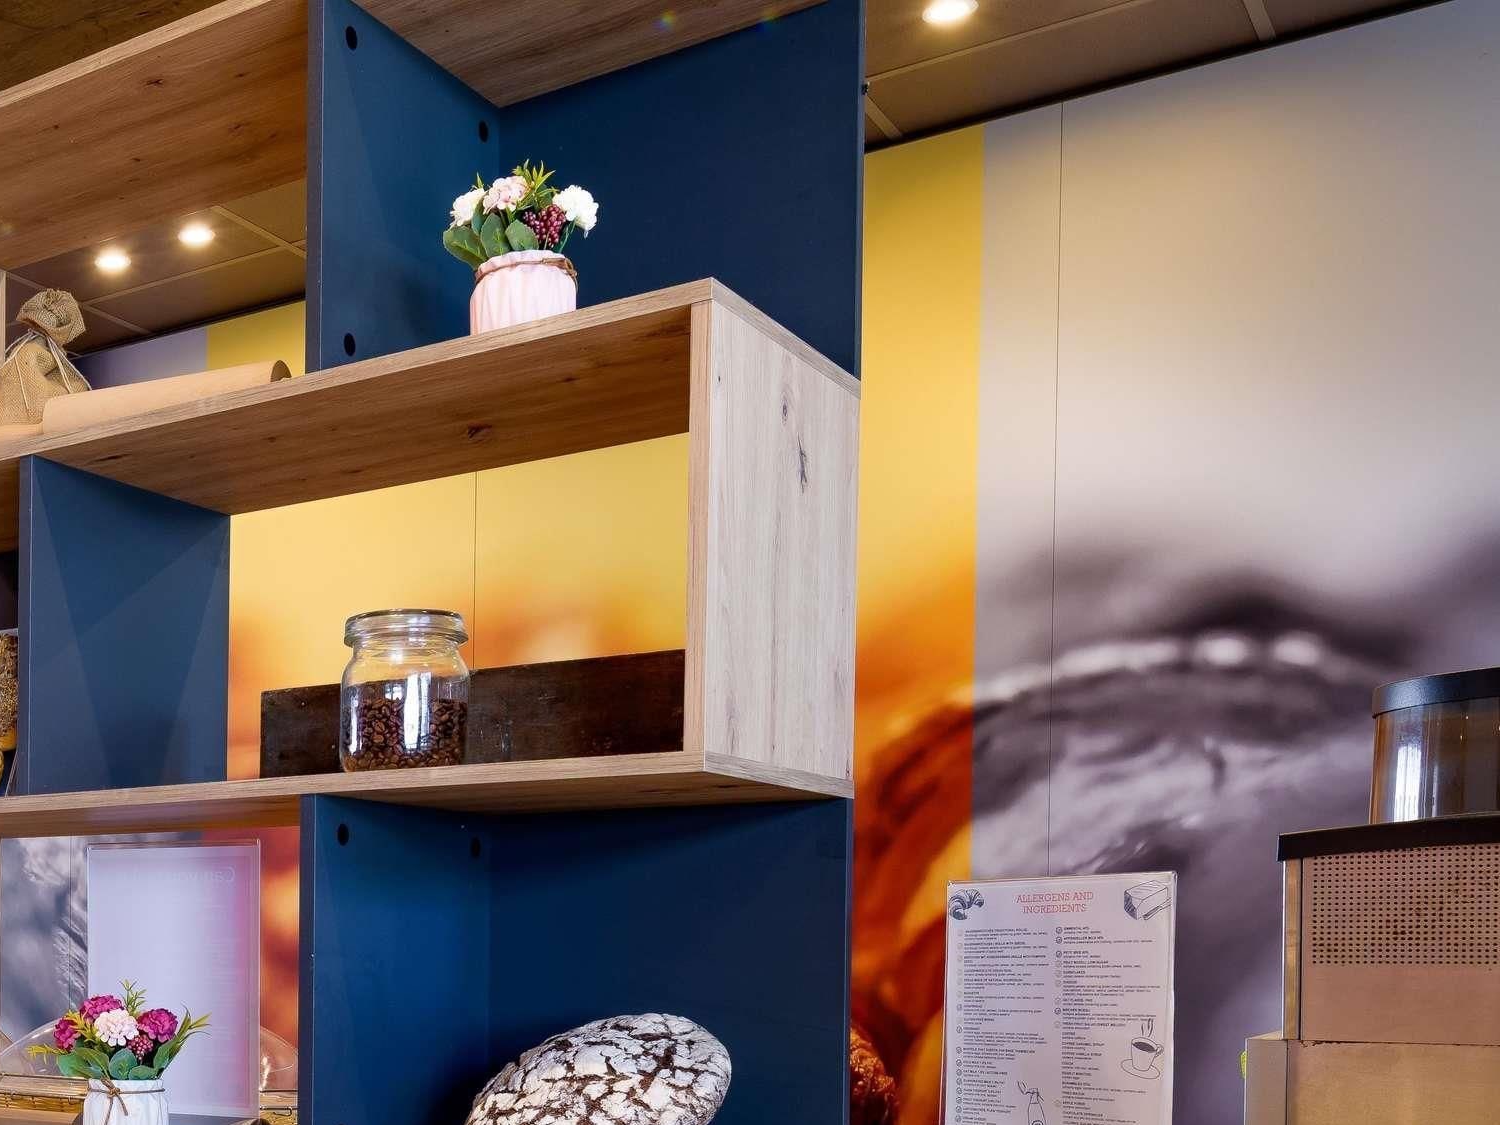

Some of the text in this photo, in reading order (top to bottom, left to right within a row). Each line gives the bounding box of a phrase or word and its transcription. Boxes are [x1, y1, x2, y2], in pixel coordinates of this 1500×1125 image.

[1016, 892, 1093, 903] ALLERGENS AND
[1022, 904, 1086, 914] INGREDIENTS
